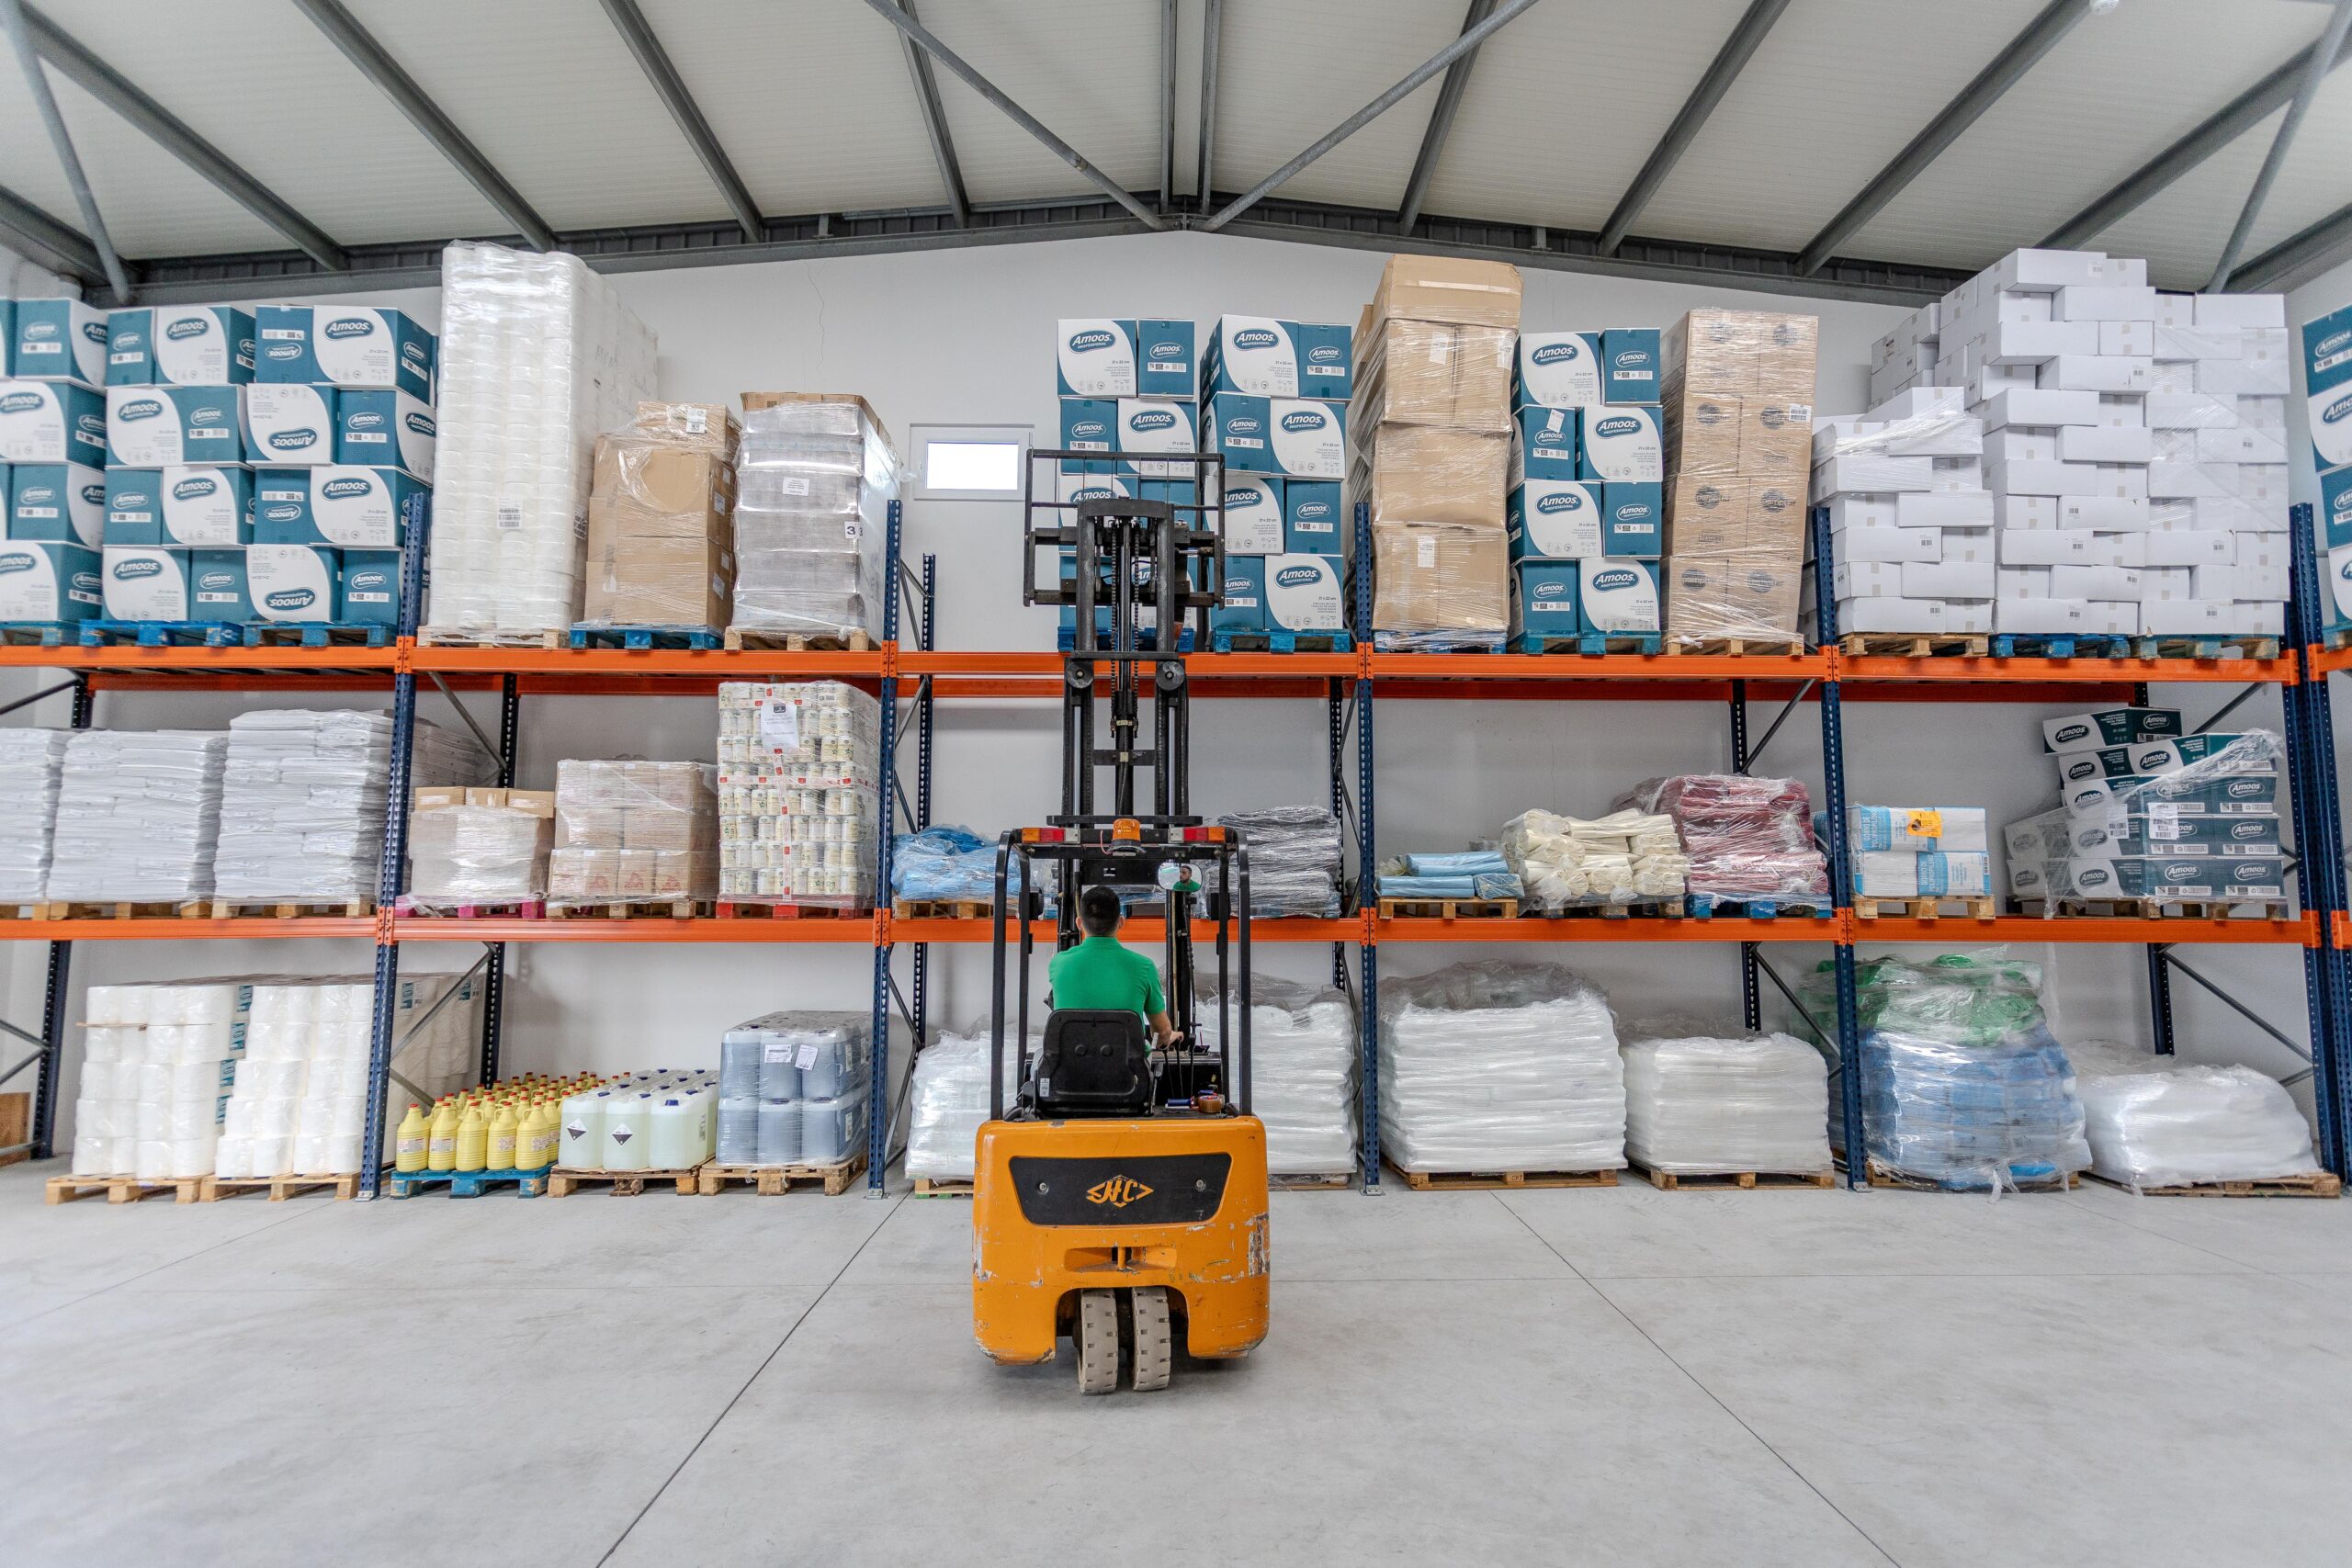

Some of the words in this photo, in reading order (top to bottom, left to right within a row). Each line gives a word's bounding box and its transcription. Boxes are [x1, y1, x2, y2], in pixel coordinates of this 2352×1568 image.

[169, 321, 205, 333] Amoos
[328, 322, 369, 332] Amoos
[1073, 334, 1110, 345] Amoos
[1237, 333, 1273, 343] Amoos
[1534, 346, 1573, 359] Amoos
[122, 403, 159, 413] Amoos
[2325, 398, 2352, 420] Amo
[1133, 415, 1170, 424] Amoos
[1284, 416, 1321, 424] Amoos
[1599, 421, 1636, 431] Amoos
[175, 481, 212, 493] Amoos
[326, 481, 367, 491] Amoos
[1540, 496, 1577, 507] Amoos
[847, 526, 855, 535] 3
[0, 557, 32, 565] moos
[116, 562, 157, 572] Amoos
[1279, 570, 1317, 581] Amoos
[1595, 574, 1634, 584] Amoos
[2057, 727, 2086, 739] Amoos
[2142, 752, 2167, 765] Amoos
[2071, 763, 2092, 774] Amoos
[2233, 784, 2260, 792] Amoos
[2168, 867, 2197, 875] Amoos
[2081, 873, 2105, 882] Amoos
